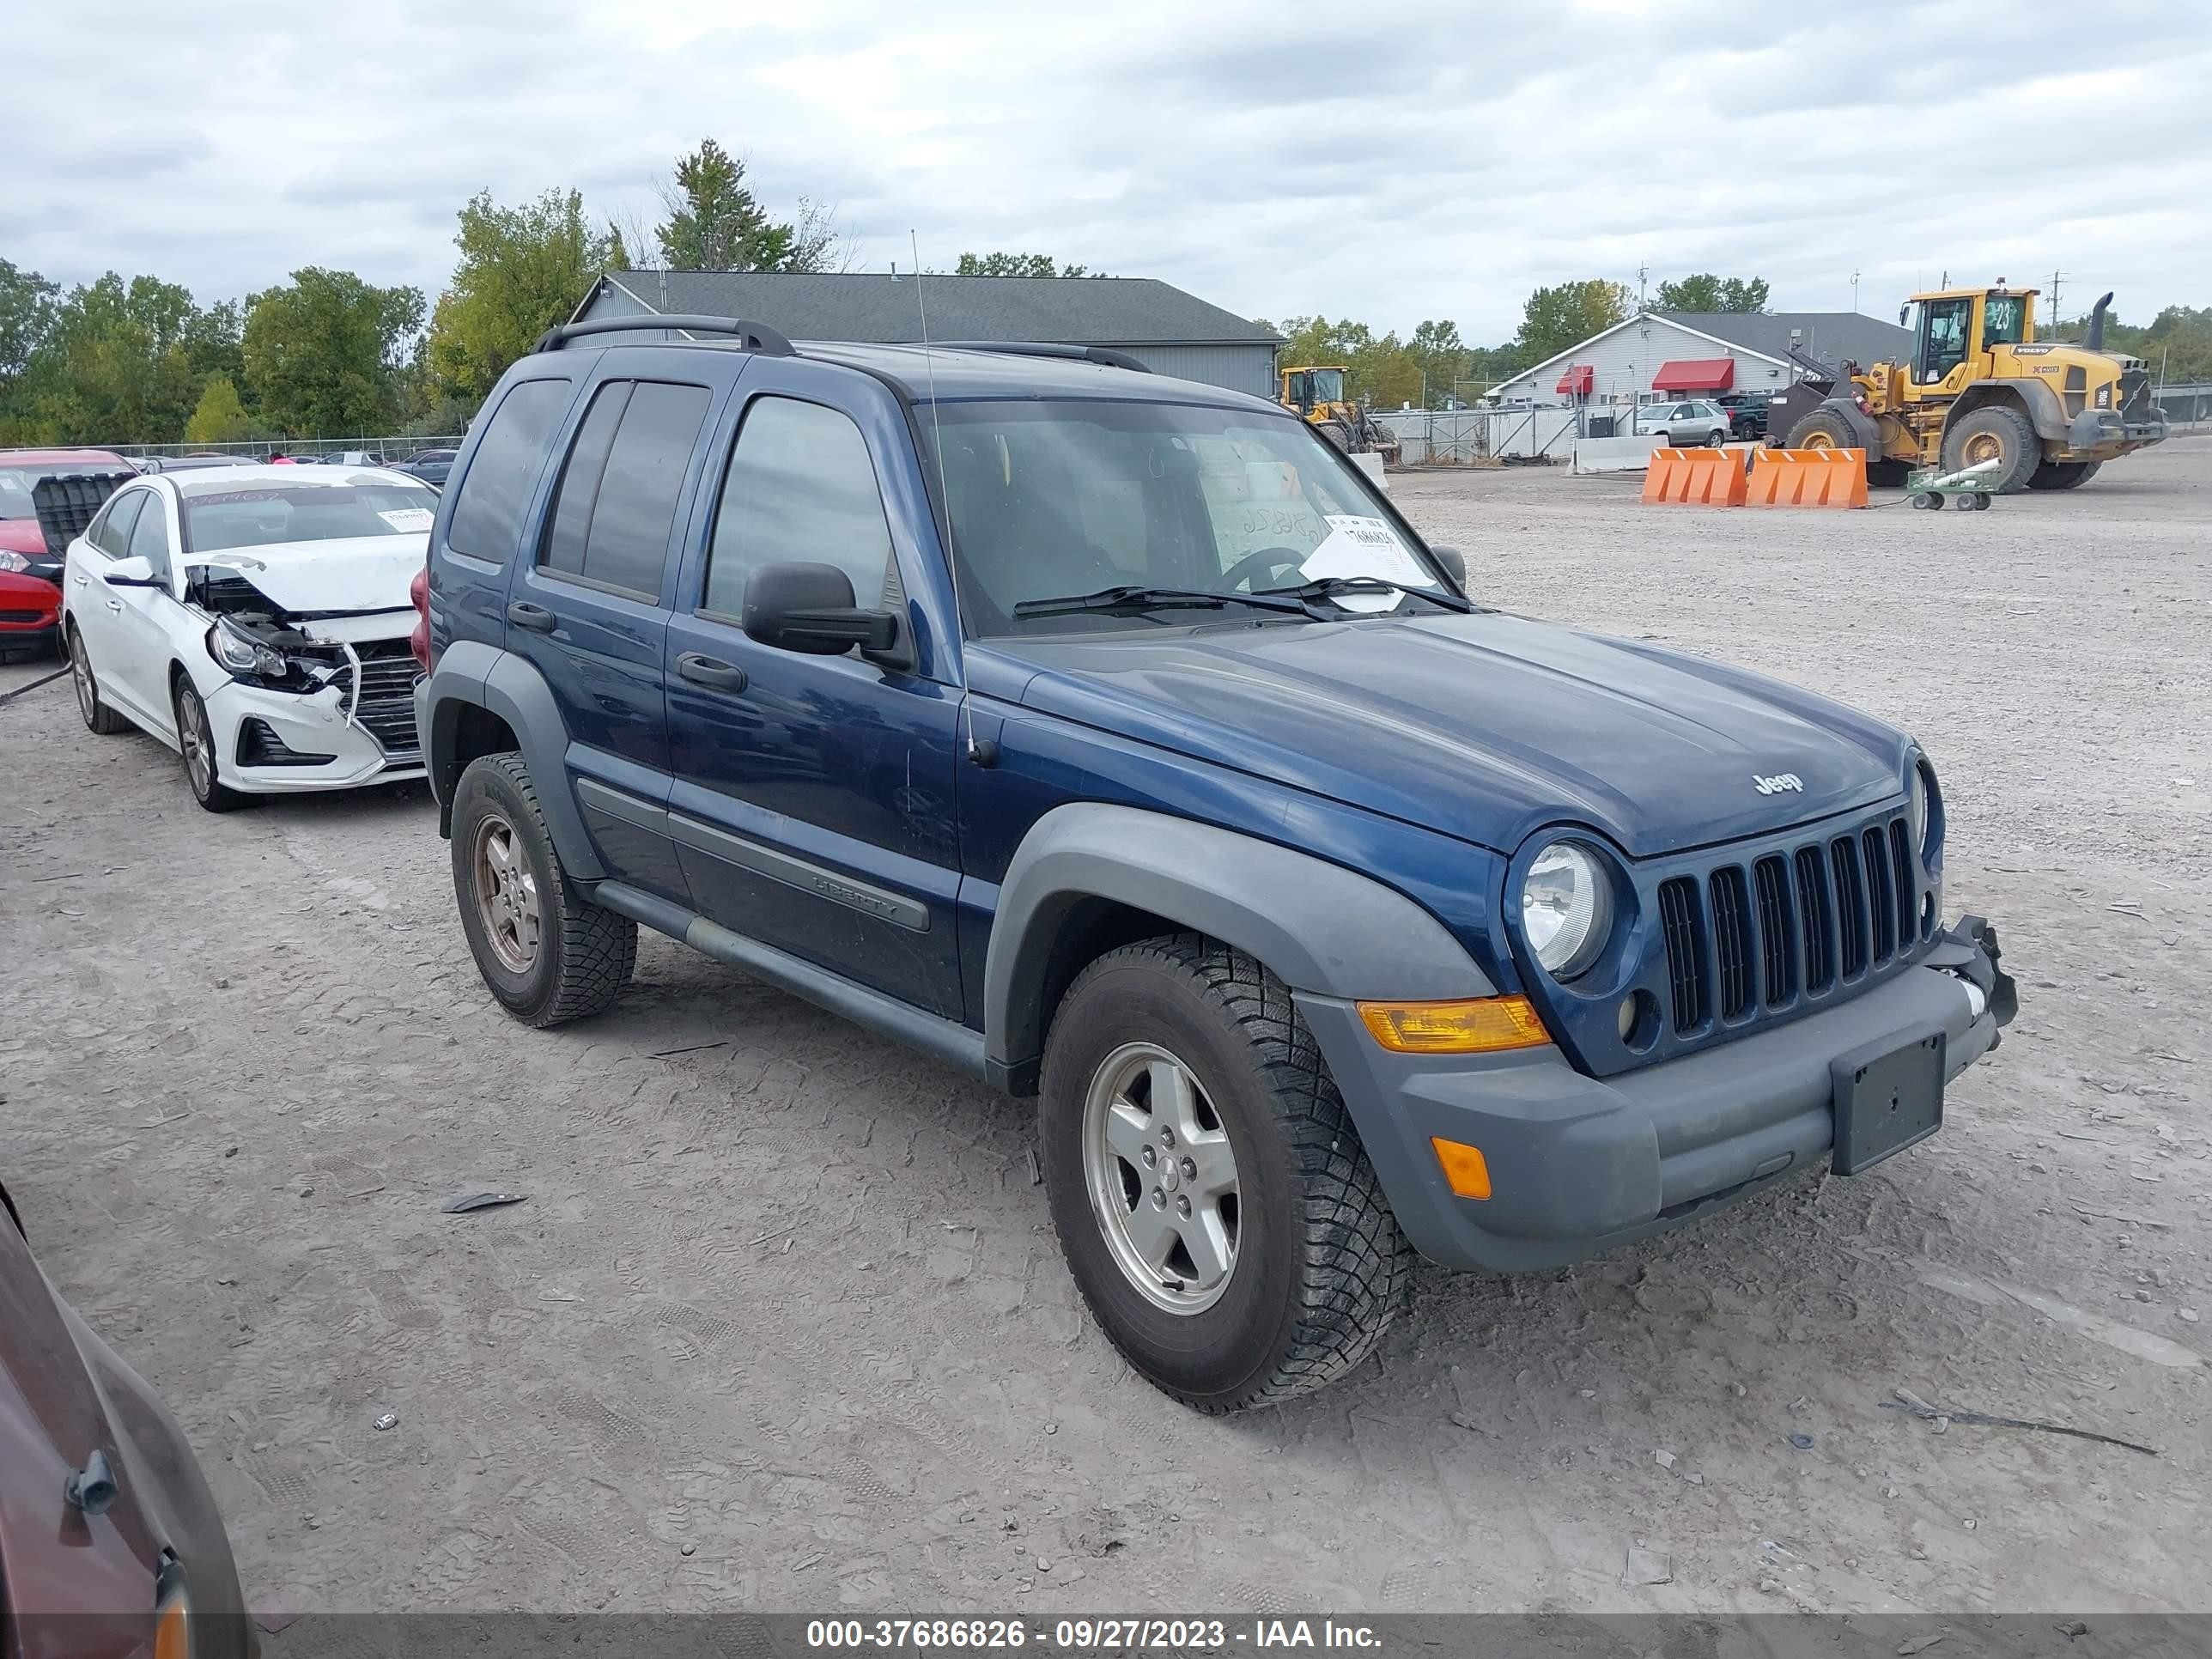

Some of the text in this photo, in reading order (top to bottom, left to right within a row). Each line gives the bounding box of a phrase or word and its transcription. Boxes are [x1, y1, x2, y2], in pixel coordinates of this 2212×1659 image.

[1996, 302, 2010, 330] 23
[1752, 773, 1804, 795] Jeep
[812, 877, 898, 915] LIBERTY
